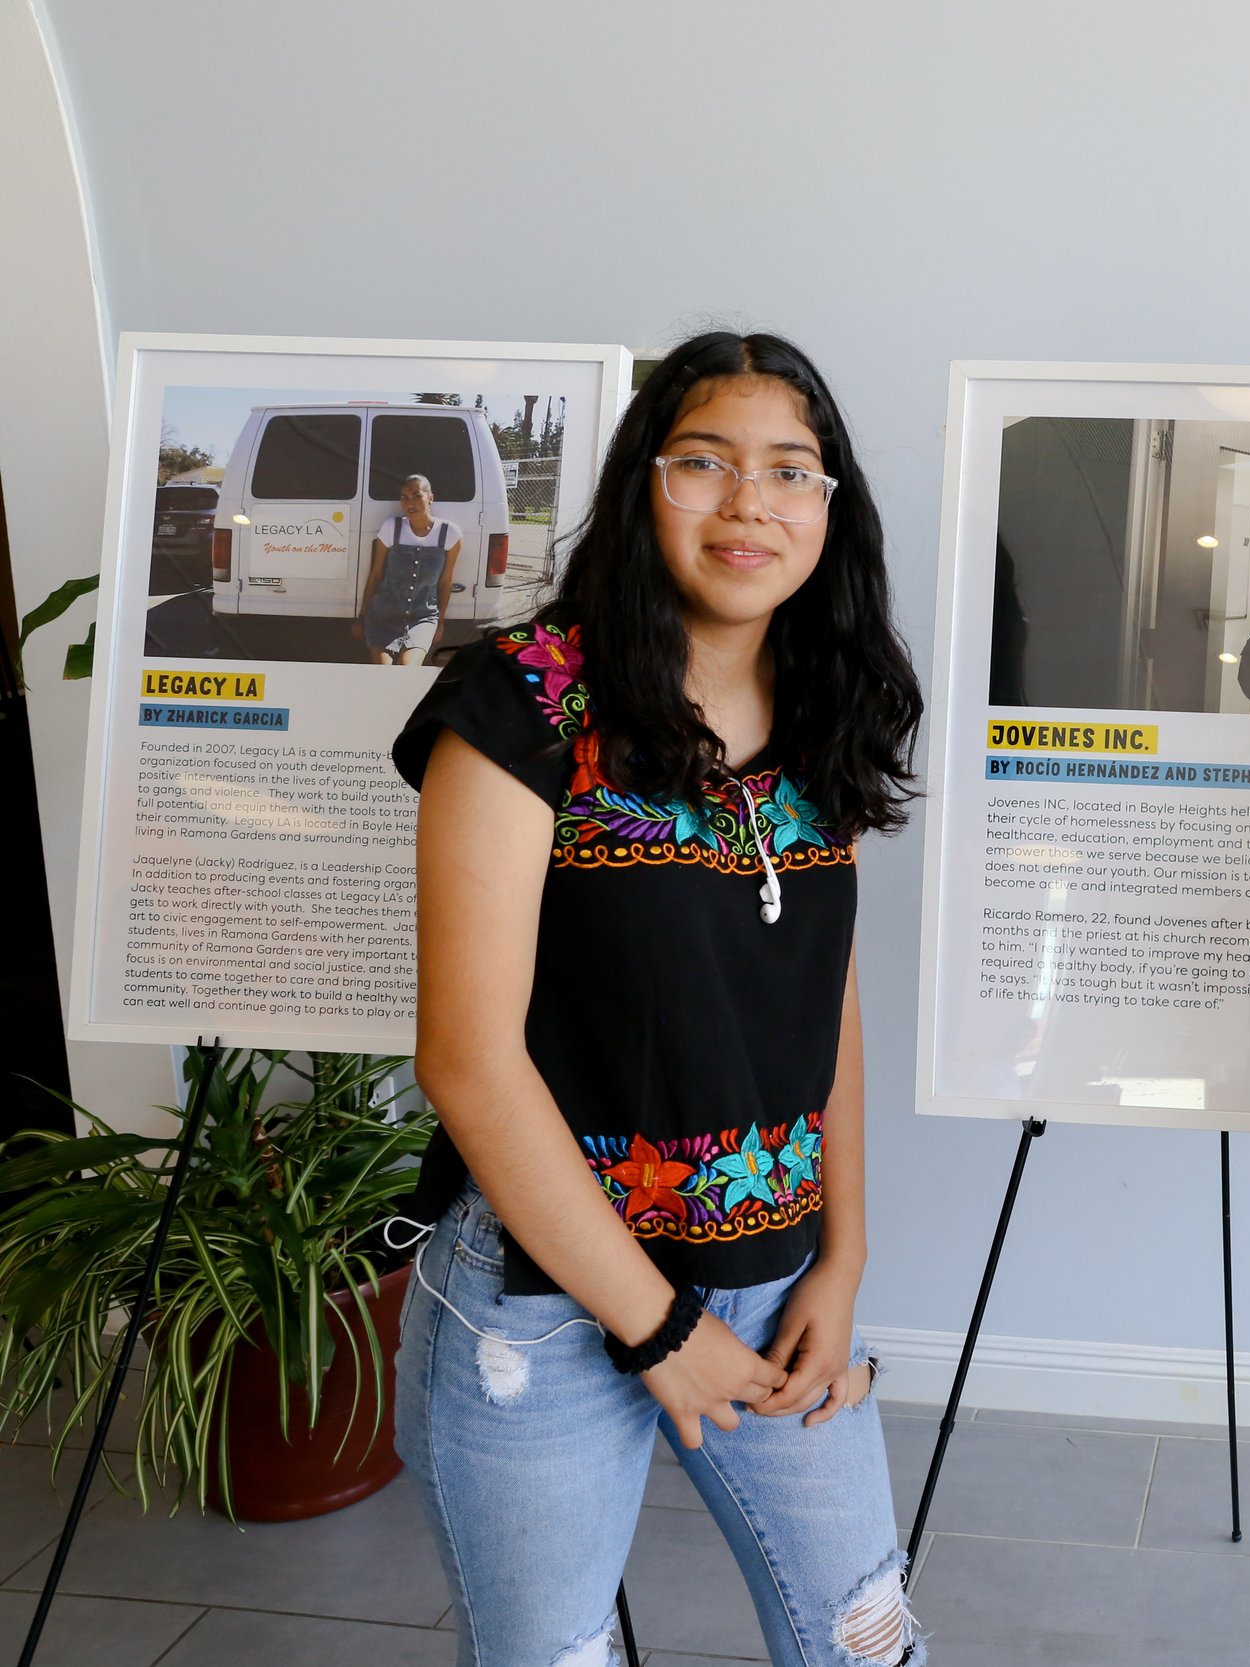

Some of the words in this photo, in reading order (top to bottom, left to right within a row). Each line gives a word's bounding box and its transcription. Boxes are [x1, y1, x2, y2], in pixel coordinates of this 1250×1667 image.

[255, 525, 303, 535] LEGACY
[263, 543, 291, 554] Youth
[304, 544, 318, 553] the
[318, 543, 347, 553] Move
[146, 674, 227, 696] LEGACY
[235, 677, 258, 697] LA
[143, 708, 163, 721] BY
[167, 709, 228, 724] ZHARICK
[233, 712, 283, 726] GARCIA
[992, 725, 1095, 748] JOVENES
[1104, 728, 1149, 751] INC.
[141, 741, 190, 753] Founded
[192, 742, 203, 754] in
[240, 744, 279, 759] Legacy
[282, 745, 296, 757] LA
[298, 745, 307, 757] is
[309, 749, 317, 757] a
[139, 755, 210, 771] organization
[213, 757, 257, 770] focused
[259, 762, 273, 770] on
[276, 759, 308, 774] youth
[990, 760, 1010, 774] BY
[1015, 758, 1061, 776] ROCÍO
[1066, 761, 1160, 780] HERNÁNDEZ
[1165, 766, 1197, 781] AND
[987, 795, 1040, 810] Jovenes
[1073, 798, 1121, 813] located
[1125, 800, 1136, 813] in
[1140, 800, 1175, 818] Boyle
[1179, 802, 1227, 820] Heights
[987, 811, 1015, 825] their
[1019, 812, 1051, 830] cycle
[1054, 813, 1066, 827] of
[1070, 814, 1156, 830] homelessness
[1160, 817, 1175, 834] by
[1179, 818, 1232, 836] focusing
[135, 824, 164, 840] living
[167, 826, 177, 837] in
[180, 826, 227, 839] Ramona
[230, 828, 276, 841] Gardens
[279, 830, 301, 842] and
[304, 830, 369, 847] surrounding
[1132, 832, 1214, 852] employment
[1217, 835, 1243, 849] and
[132, 853, 192, 870] Jaquelyne
[195, 855, 235, 871] (Jacky)
[300, 859, 308, 871] is
[310, 863, 319, 871] a
[322, 860, 382, 876] Leadership
[985, 859, 1015, 873] does
[1018, 861, 1040, 874] not
[1043, 861, 1083, 876] define
[1086, 867, 1107, 877] our
[1153, 865, 1176, 879] Our
[1180, 866, 1227, 881] mission
[1231, 868, 1240, 881] is
[130, 881, 165, 897] Jacky
[167, 883, 211, 896] teaches
[283, 887, 322, 899] classes
[325, 889, 337, 900] at
[340, 889, 380, 904] Legacy
[984, 875, 1036, 890] become
[1039, 877, 1078, 891] active
[1081, 878, 1106, 892] and
[1110, 879, 1178, 899] integrated
[1181, 882, 1242, 897] members
[983, 907, 1031, 922] Ricardo
[1114, 912, 1151, 926] found
[1154, 913, 1207, 929] Jovenes
[1211, 916, 1241, 930] after
[181, 926, 205, 938] lives
[208, 927, 218, 938] in
[221, 927, 268, 940] Ramona
[271, 929, 317, 942] Gardens
[320, 931, 344, 943] with
[347, 932, 365, 944] her
[126, 952, 155, 965] focus
[158, 954, 166, 965] is
[168, 957, 183, 966] on
[186, 955, 266, 969] environmental
[268, 958, 291, 970] and
[294, 959, 325, 971] social
[369, 962, 391, 974] and
[394, 962, 413, 975] she
[125, 966, 173, 980] students
[176, 969, 188, 980] to
[190, 972, 221, 981] come
[224, 970, 273, 986] together
[275, 973, 287, 984] to
[289, 976, 315, 985] care
[317, 974, 339, 986] and
[342, 975, 371, 990] bring
[374, 976, 416, 992] positive
